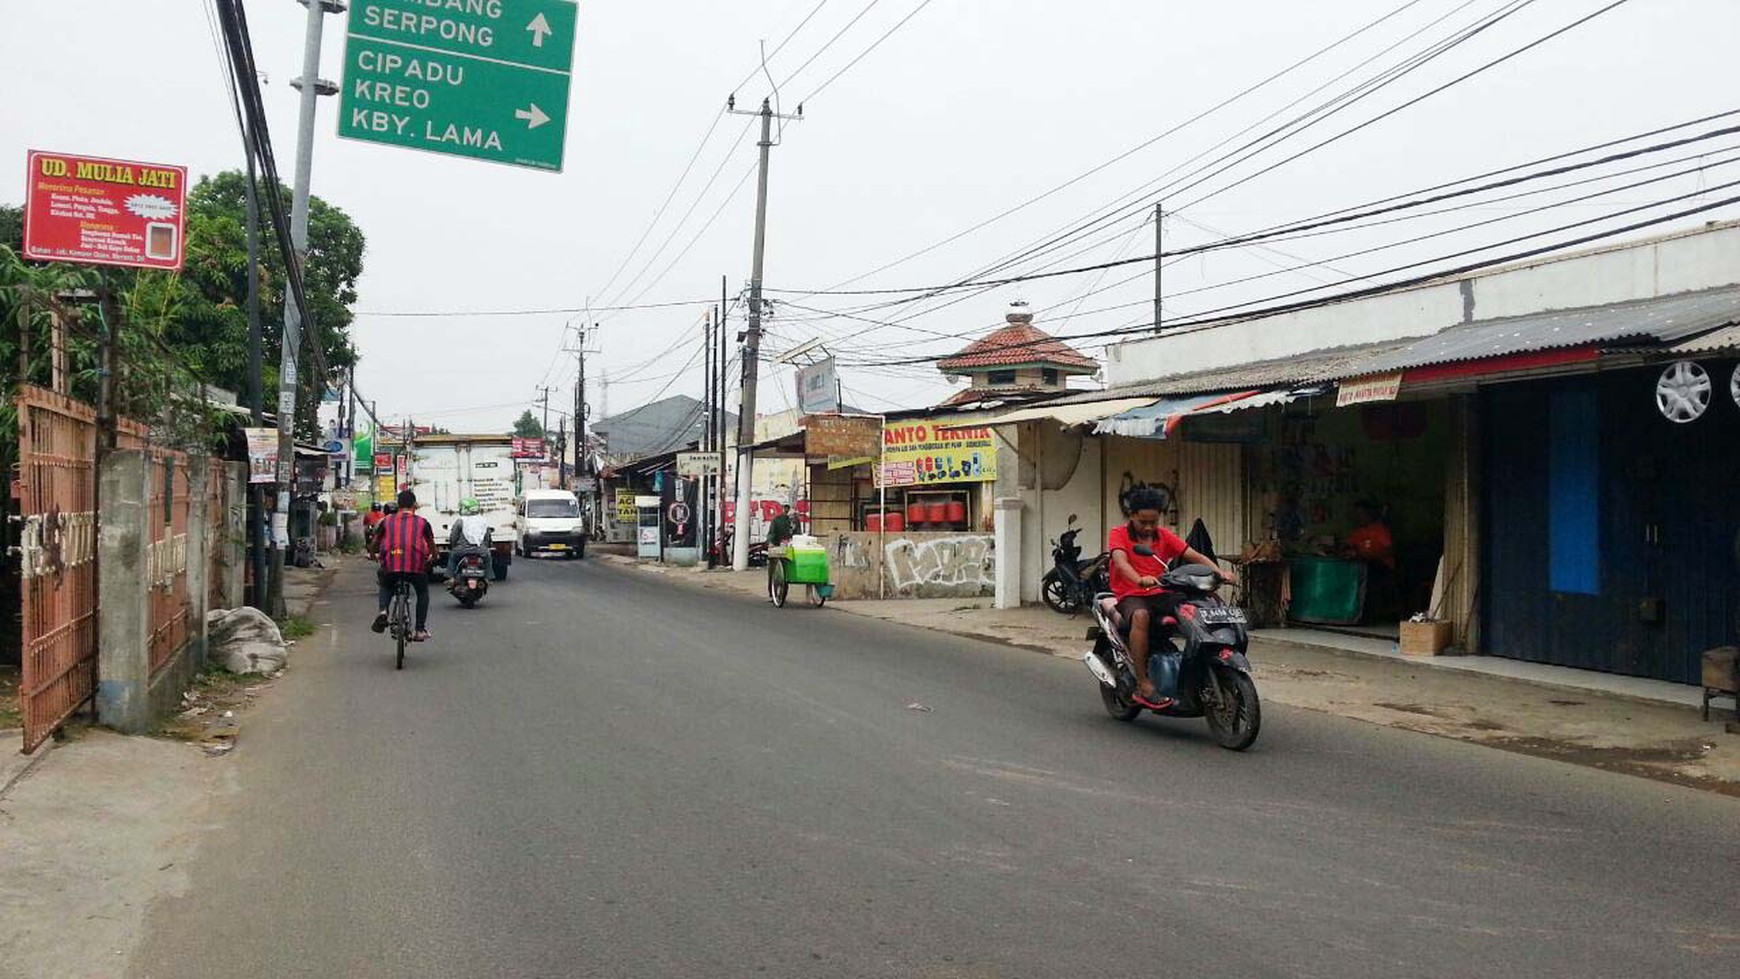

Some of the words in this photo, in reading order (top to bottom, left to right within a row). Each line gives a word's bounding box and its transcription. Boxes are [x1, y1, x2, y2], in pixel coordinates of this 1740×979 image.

[364, 5, 494, 47] SERPONG
[358, 50, 464, 86] CIPADU
[355, 78, 430, 109] KREO
[352, 107, 415, 137] KBY.
[426, 120, 502, 151] LAMA
[41, 159, 70, 178] UD.
[76, 161, 134, 184] MULIA
[138, 168, 175, 188] JATI
